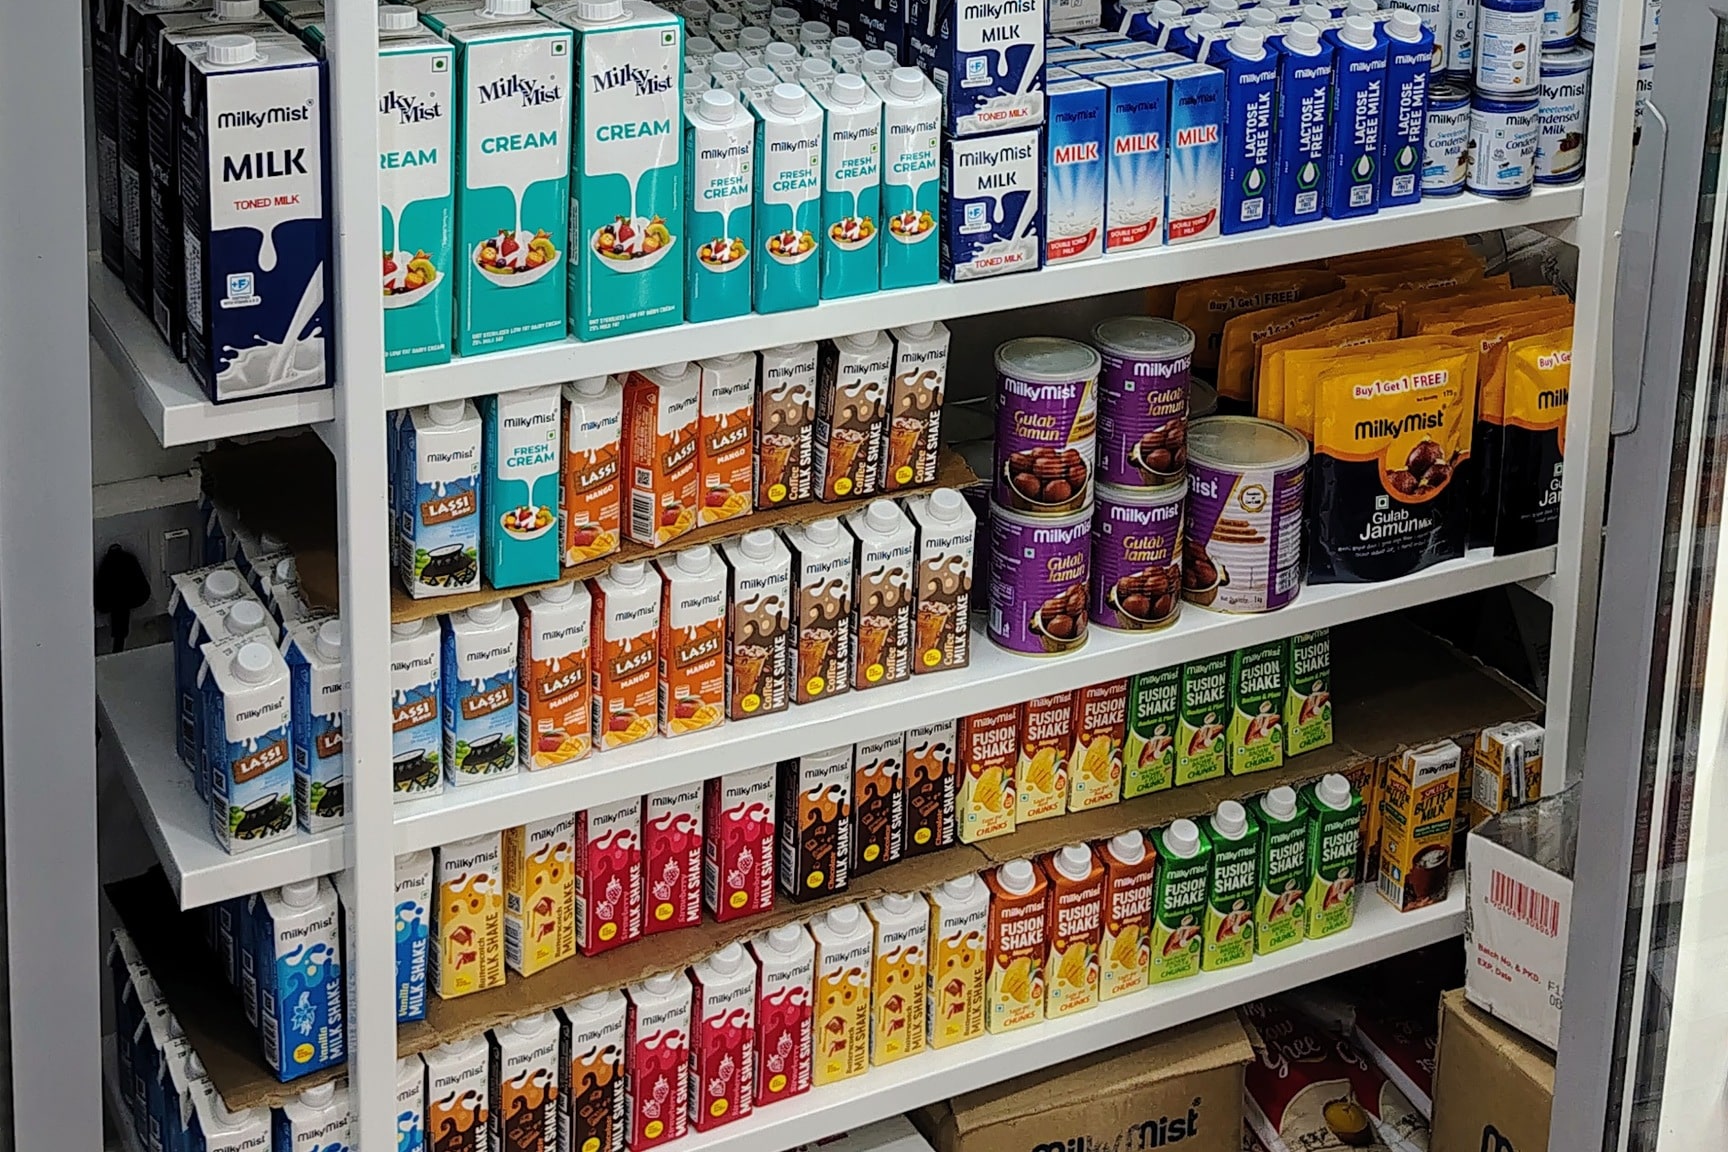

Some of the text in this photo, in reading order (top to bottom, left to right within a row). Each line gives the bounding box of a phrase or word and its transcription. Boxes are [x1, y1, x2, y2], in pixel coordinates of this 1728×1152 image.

[982, 24, 1020, 43] MILK
[592, 63, 651, 94] Milky
[634, 74, 673, 97] Mist
[478, 74, 537, 105] Milky
[520, 86, 562, 108] Mist
[977, 108, 1028, 122] TONED MILK
[1300, 96, 1314, 152] LACTOSE
[1310, 87, 1326, 158] FREE MILK
[1354, 90, 1368, 144] LACTOSE
[1366, 80, 1381, 152] FREE MILK
[596, 119, 671, 142] CREAM
[1178, 126, 1217, 146] MILK
[1245, 102, 1258, 158] LACTOSE
[1256, 92, 1271, 165] FREE MILK
[1542, 124, 1565, 135] Milk
[481, 131, 558, 154] CREAM
[1115, 134, 1158, 154] MILK
[841, 156, 872, 168] FRESH
[900, 151, 931, 162] FRESH
[1055, 144, 1097, 164] MILK
[222, 147, 308, 183] MILK
[780, 169, 812, 180] FRESH
[834, 164, 877, 180] CREAM
[893, 159, 936, 173] CREAM
[711, 175, 743, 187] FRESH
[772, 177, 817, 192] CREAM
[978, 171, 1017, 190] MILK
[704, 184, 748, 199] CREAM
[234, 194, 300, 211] TONED MILK
[975, 253, 1023, 268] TONED MILK
[1210, 301, 1227, 311] Buy
[1237, 296, 1253, 307] Get
[1355, 385, 1374, 397] Buy
[1376, 382, 1380, 393] 1
[1383, 380, 1400, 392] Get
[1402, 377, 1408, 389] 1
[1014, 410, 1056, 427] Gulab
[711, 426, 748, 450] LASSI
[1015, 425, 1060, 442] Jamun
[514, 444, 549, 456] FRESH
[924, 409, 940, 482] MILK SHAKE
[506, 453, 555, 468] CREAM
[717, 449, 746, 464] MANGO
[914, 450, 925, 484] Coffee
[580, 462, 616, 487] LASSI
[585, 484, 614, 503] MANGO
[429, 497, 469, 517] LASSI
[1372, 508, 1409, 524] Gulab
[1359, 517, 1432, 542] Jamun Mix
[1123, 535, 1165, 550] Gulab
[1124, 547, 1167, 562] Jamun
[953, 592, 968, 664] MILK SHAKE
[943, 633, 953, 666] Coffee
[240, 746, 281, 774] LASSI
[835, 817, 849, 888] MILK SHAKE
[1270, 840, 1305, 861] FUSION
[1215, 859, 1255, 879] FUSION
[1269, 855, 1305, 876] SHAKE
[1215, 872, 1255, 893] SHAKE
[1059, 900, 1100, 922] FUSION
[1000, 915, 1044, 937] FUSION
[1059, 915, 1100, 937] SHAKE
[1000, 930, 1044, 951] SHAKE
[1270, 930, 1296, 947] CHUNKS
[1478, 943, 1499, 960] Batch
[1501, 955, 1513, 970] No.
[1477, 957, 1512, 982] EXP. Date
[327, 978, 344, 1060] MILK SHAKE
[1003, 1011, 1035, 1027] CHUNKS
[319, 1026, 328, 1062] Vanilla
[739, 1042, 753, 1114] MILK SHAKE
